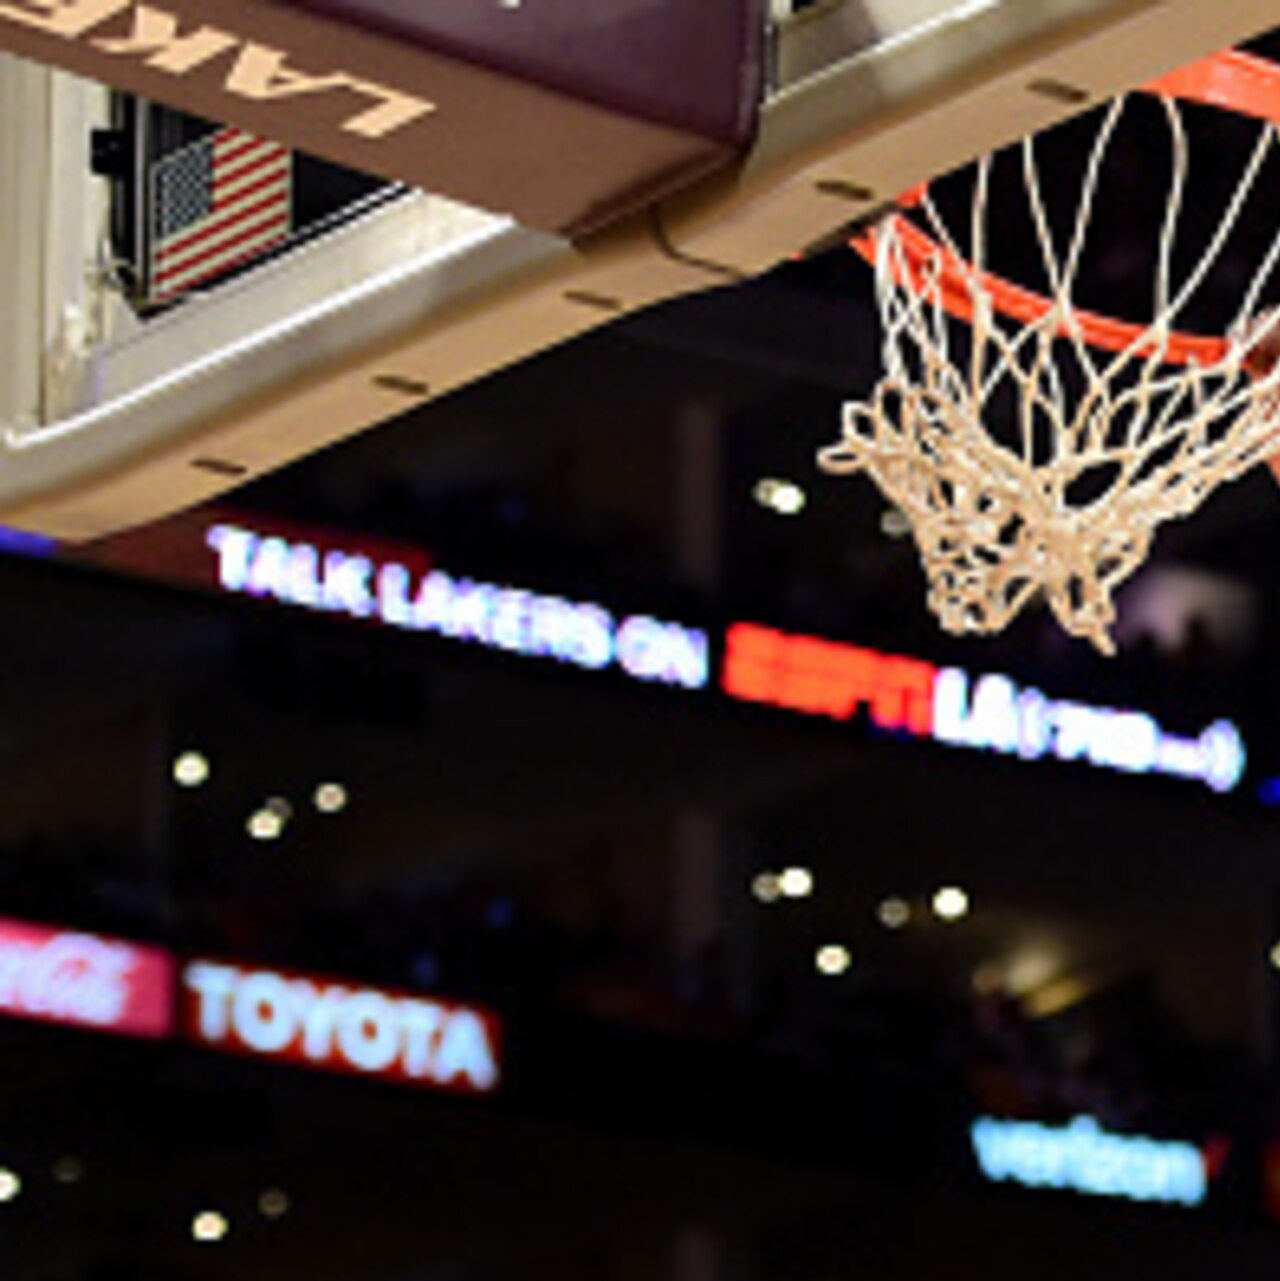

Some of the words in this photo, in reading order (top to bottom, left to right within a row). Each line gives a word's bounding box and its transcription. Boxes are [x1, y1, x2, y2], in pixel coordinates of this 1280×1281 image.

[207, 525, 377, 618] TALK
[378, 563, 614, 669] LAKERS
[615, 615, 708, 690] ON
[184, 960, 499, 1090] TOYOTA
